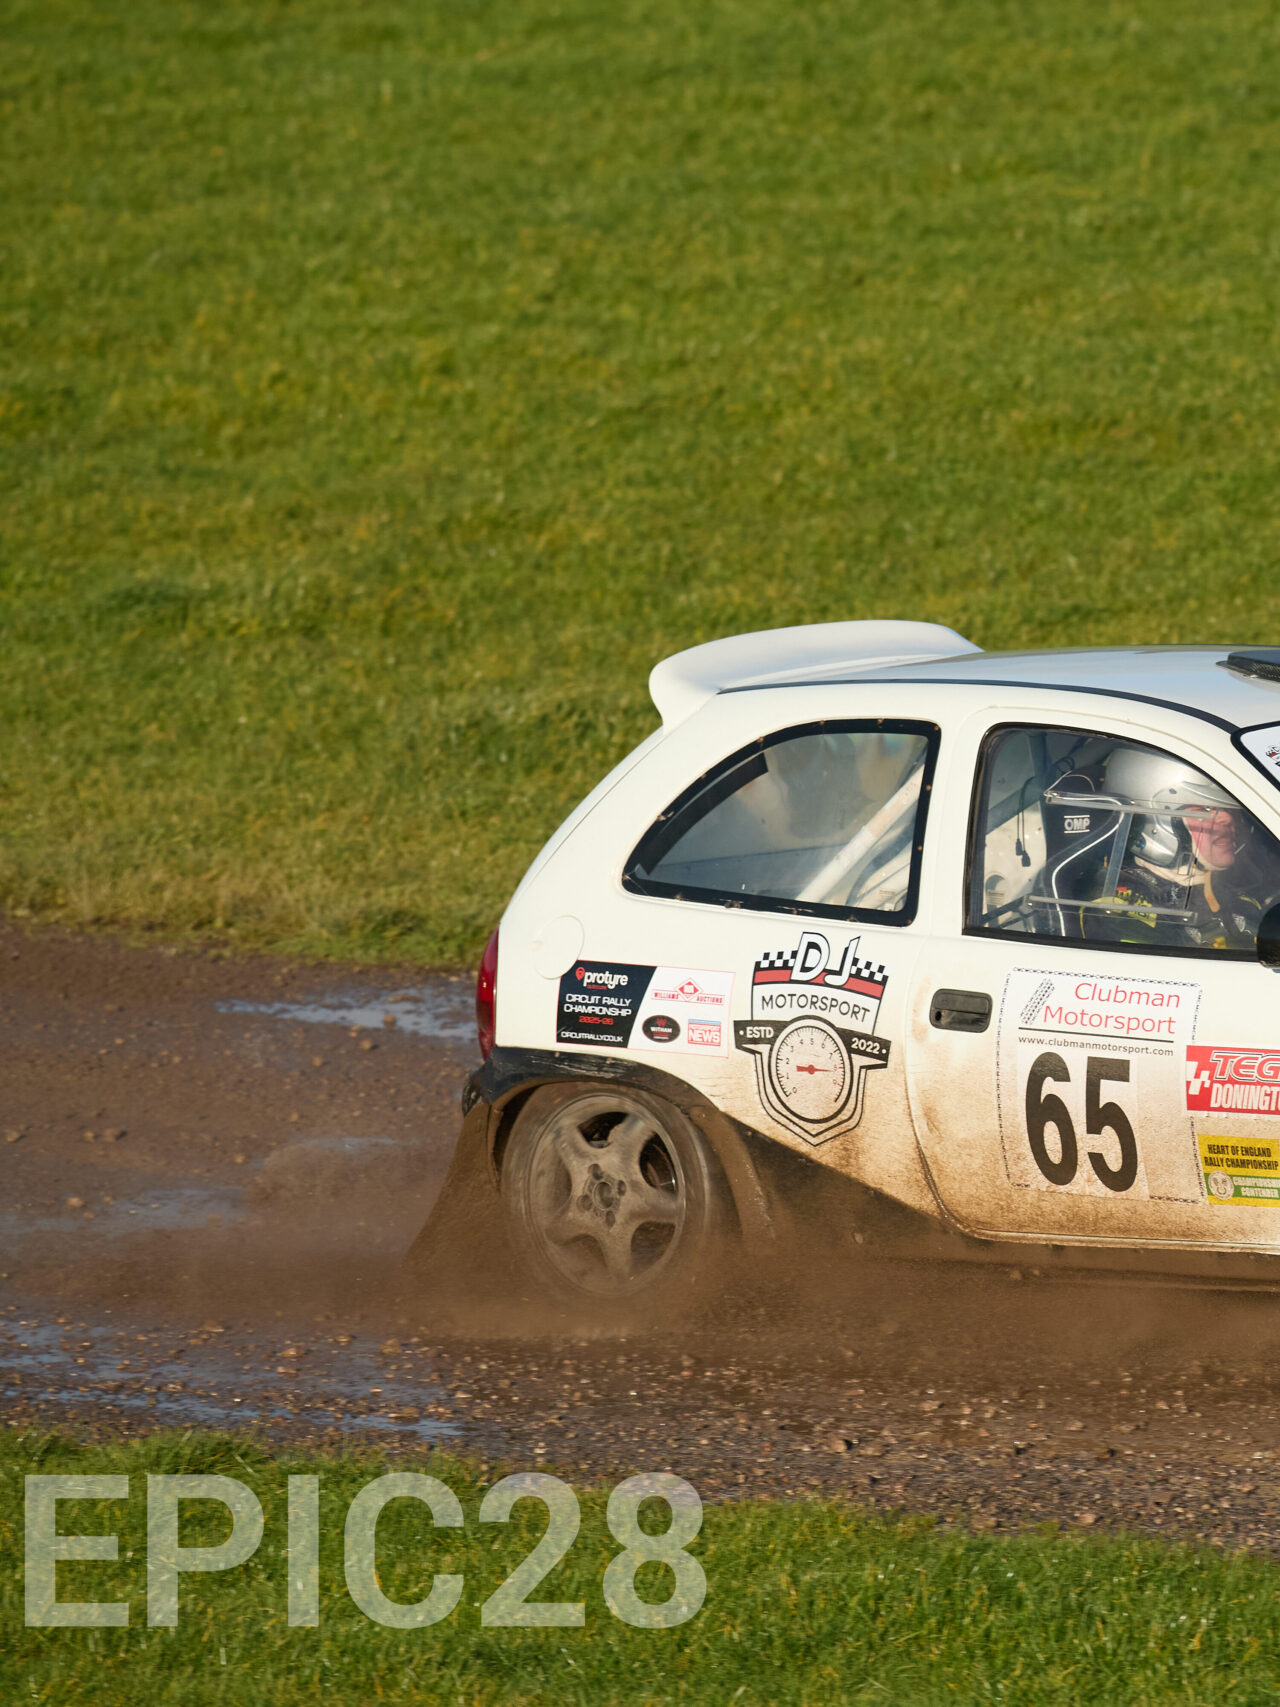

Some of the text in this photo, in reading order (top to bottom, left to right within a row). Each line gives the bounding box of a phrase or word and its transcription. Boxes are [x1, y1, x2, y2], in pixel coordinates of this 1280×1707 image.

[1064, 818, 1090, 831] OMP
[789, 931, 861, 987] DJ
[583, 971, 629, 989] protyre
[565, 993, 632, 1007] CIRCUIT RALLY
[1074, 982, 1181, 1008] Clubman
[563, 1003, 632, 1016] CHAMPIONSHIP
[761, 993, 870, 1022] MOTORSPORT
[1043, 1005, 1176, 1035] Motorsport
[688, 1029, 721, 1044] NEWS
[746, 1026, 774, 1039] ESTD
[851, 1037, 880, 1055] 2022
[1018, 1036, 1174, 1056] www.clubmanmotorsport.com
[1025, 1051, 1138, 1192] 65
[1207, 1144, 1271, 1157] HEART OF ENGLAND
[1204, 1156, 1279, 1171] RALLY CHAMPIONSHIP
